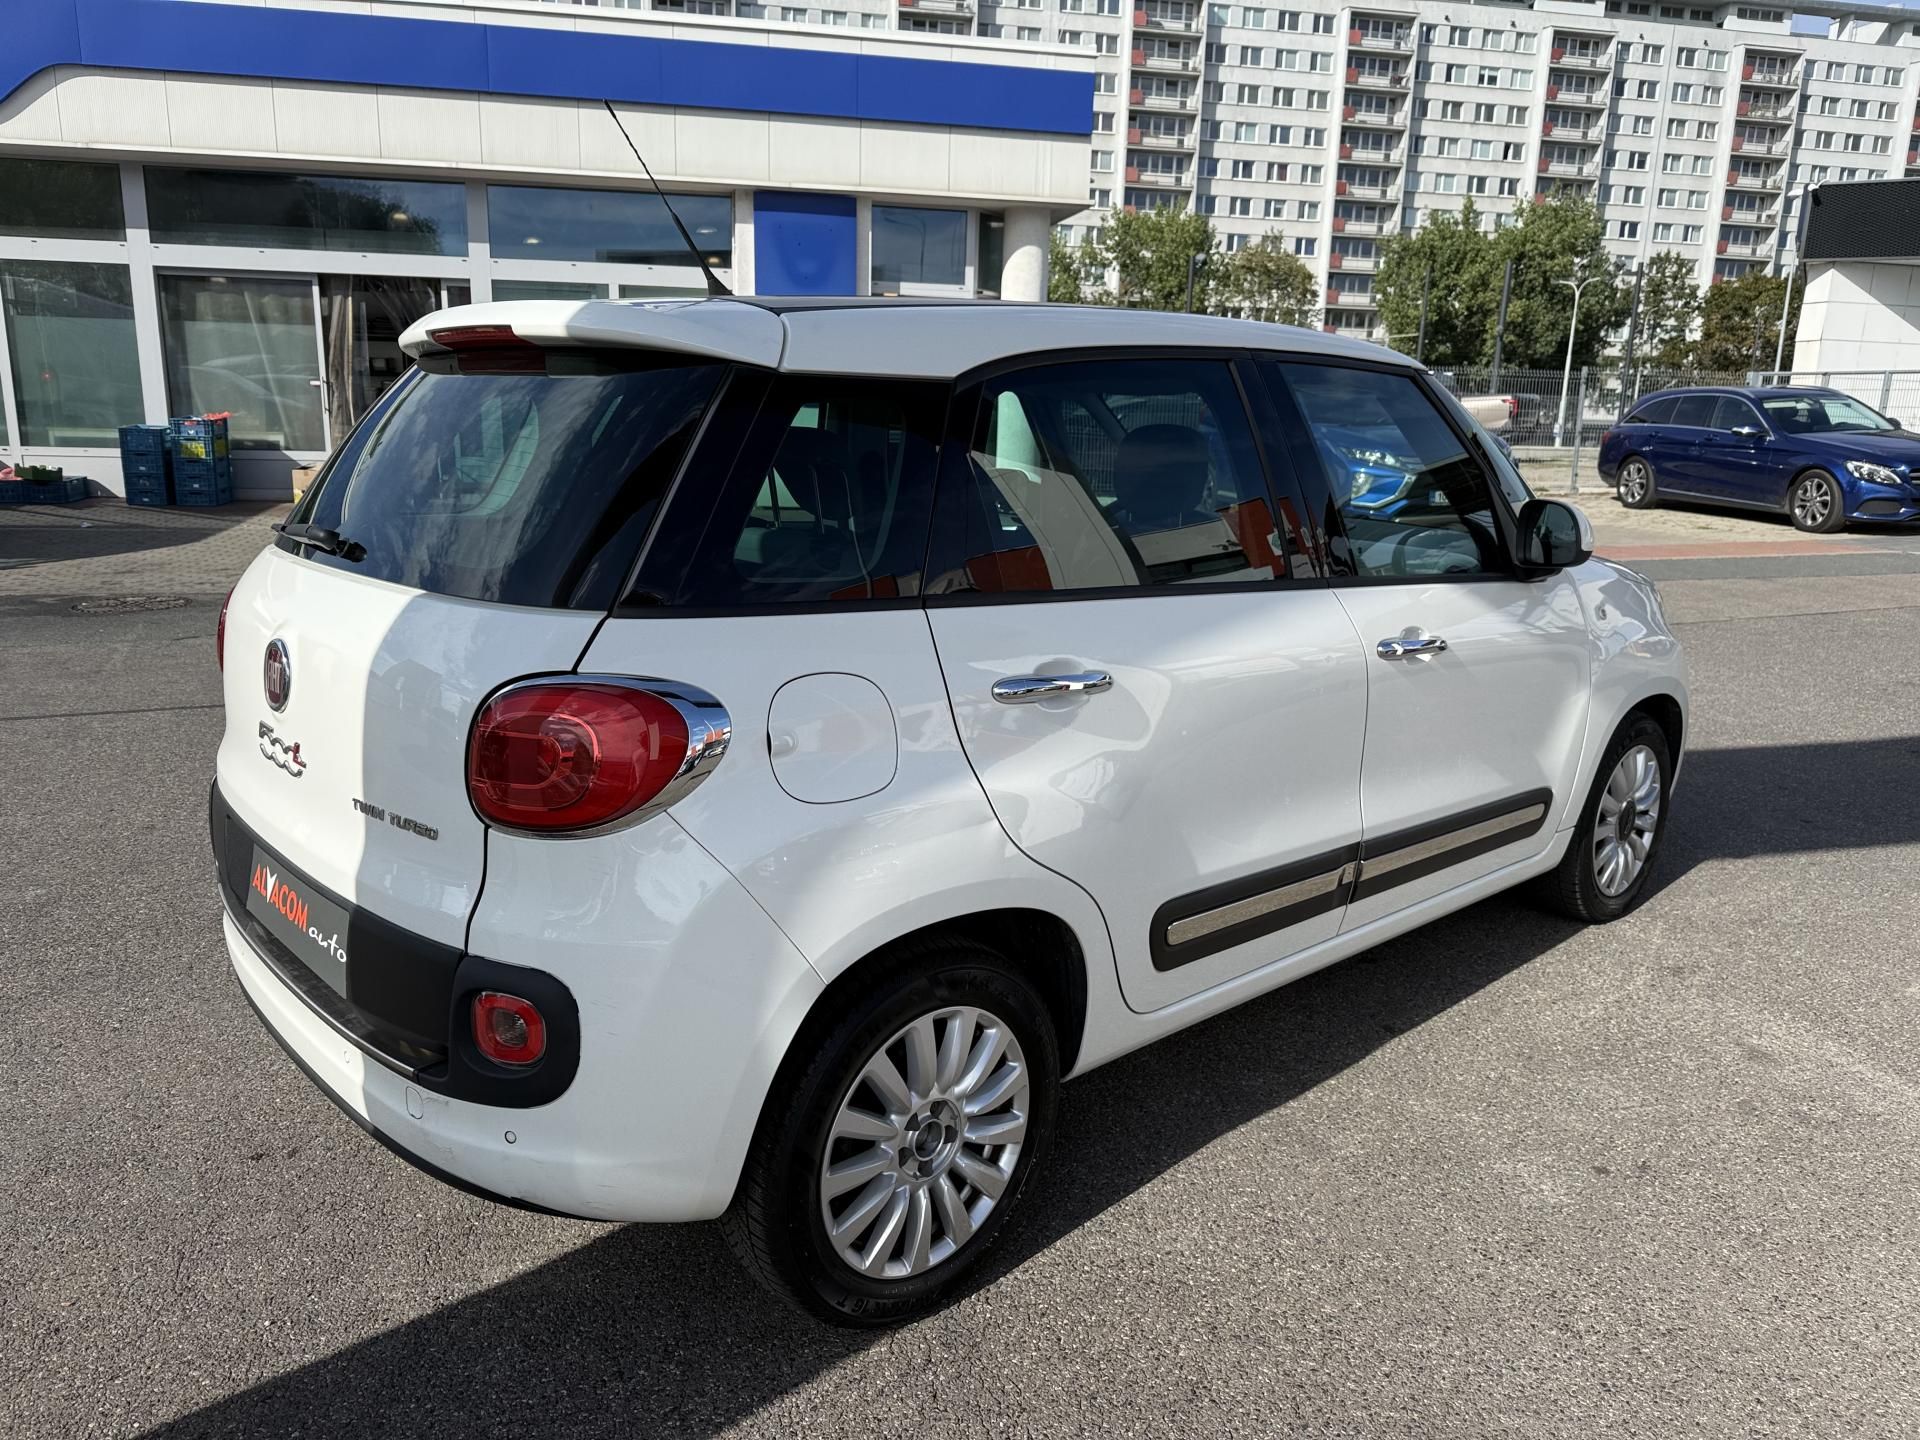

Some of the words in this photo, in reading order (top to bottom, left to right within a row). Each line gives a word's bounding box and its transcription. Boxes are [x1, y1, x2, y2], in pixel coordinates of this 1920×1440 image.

[352, 797, 385, 822] TWIN
[388, 811, 439, 841] TURBO
[308, 926, 347, 963] auto
